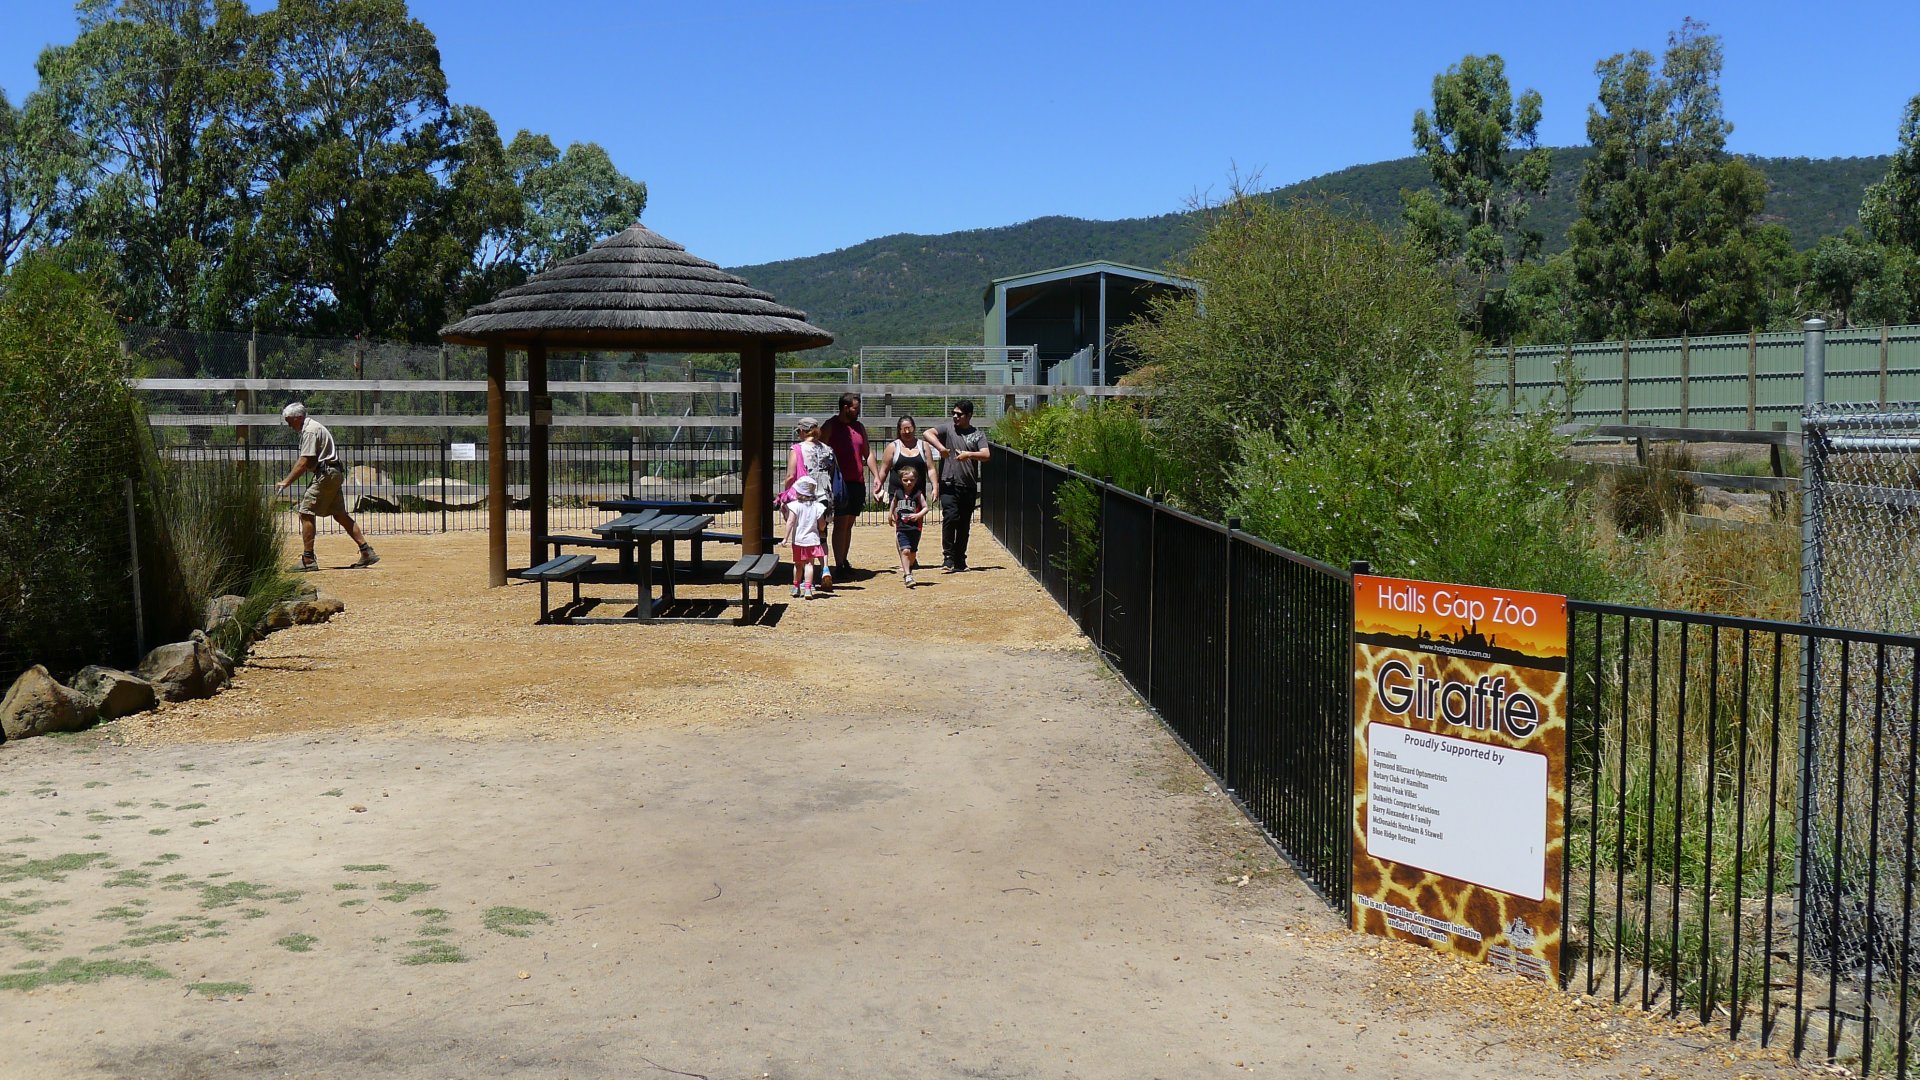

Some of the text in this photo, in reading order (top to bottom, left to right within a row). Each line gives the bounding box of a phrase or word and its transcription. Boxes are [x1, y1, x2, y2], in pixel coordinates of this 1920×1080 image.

[1378, 585, 1537, 627] Halls Gap Zoo
[1419, 643, 1491, 659] www.hallsgapzoo.com.au
[1377, 660, 1538, 738] Giraffe
[1404, 733, 1504, 764] Proudly Supported by
[1373, 759, 1448, 783] Raymond Blizzard Optometrists
[1373, 770, 1429, 790] Rotary Club of Hamilton
[1373, 782, 1418, 799] Boronia Peak Villas
[1373, 805, 1432, 827] Barry Alexander & Family
[1393, 798, 1417, 810] Computer
[1417, 804, 1440, 816] Solutions
[1373, 816, 1443, 840] McDonalds Horsham & Stawell
[1373, 827, 1416, 845] Blue Ridge Retreat
[1357, 895, 1481, 940] This is an Australian Government Initiative
[1387, 918, 1447, 943] under T-QUAL Grants
